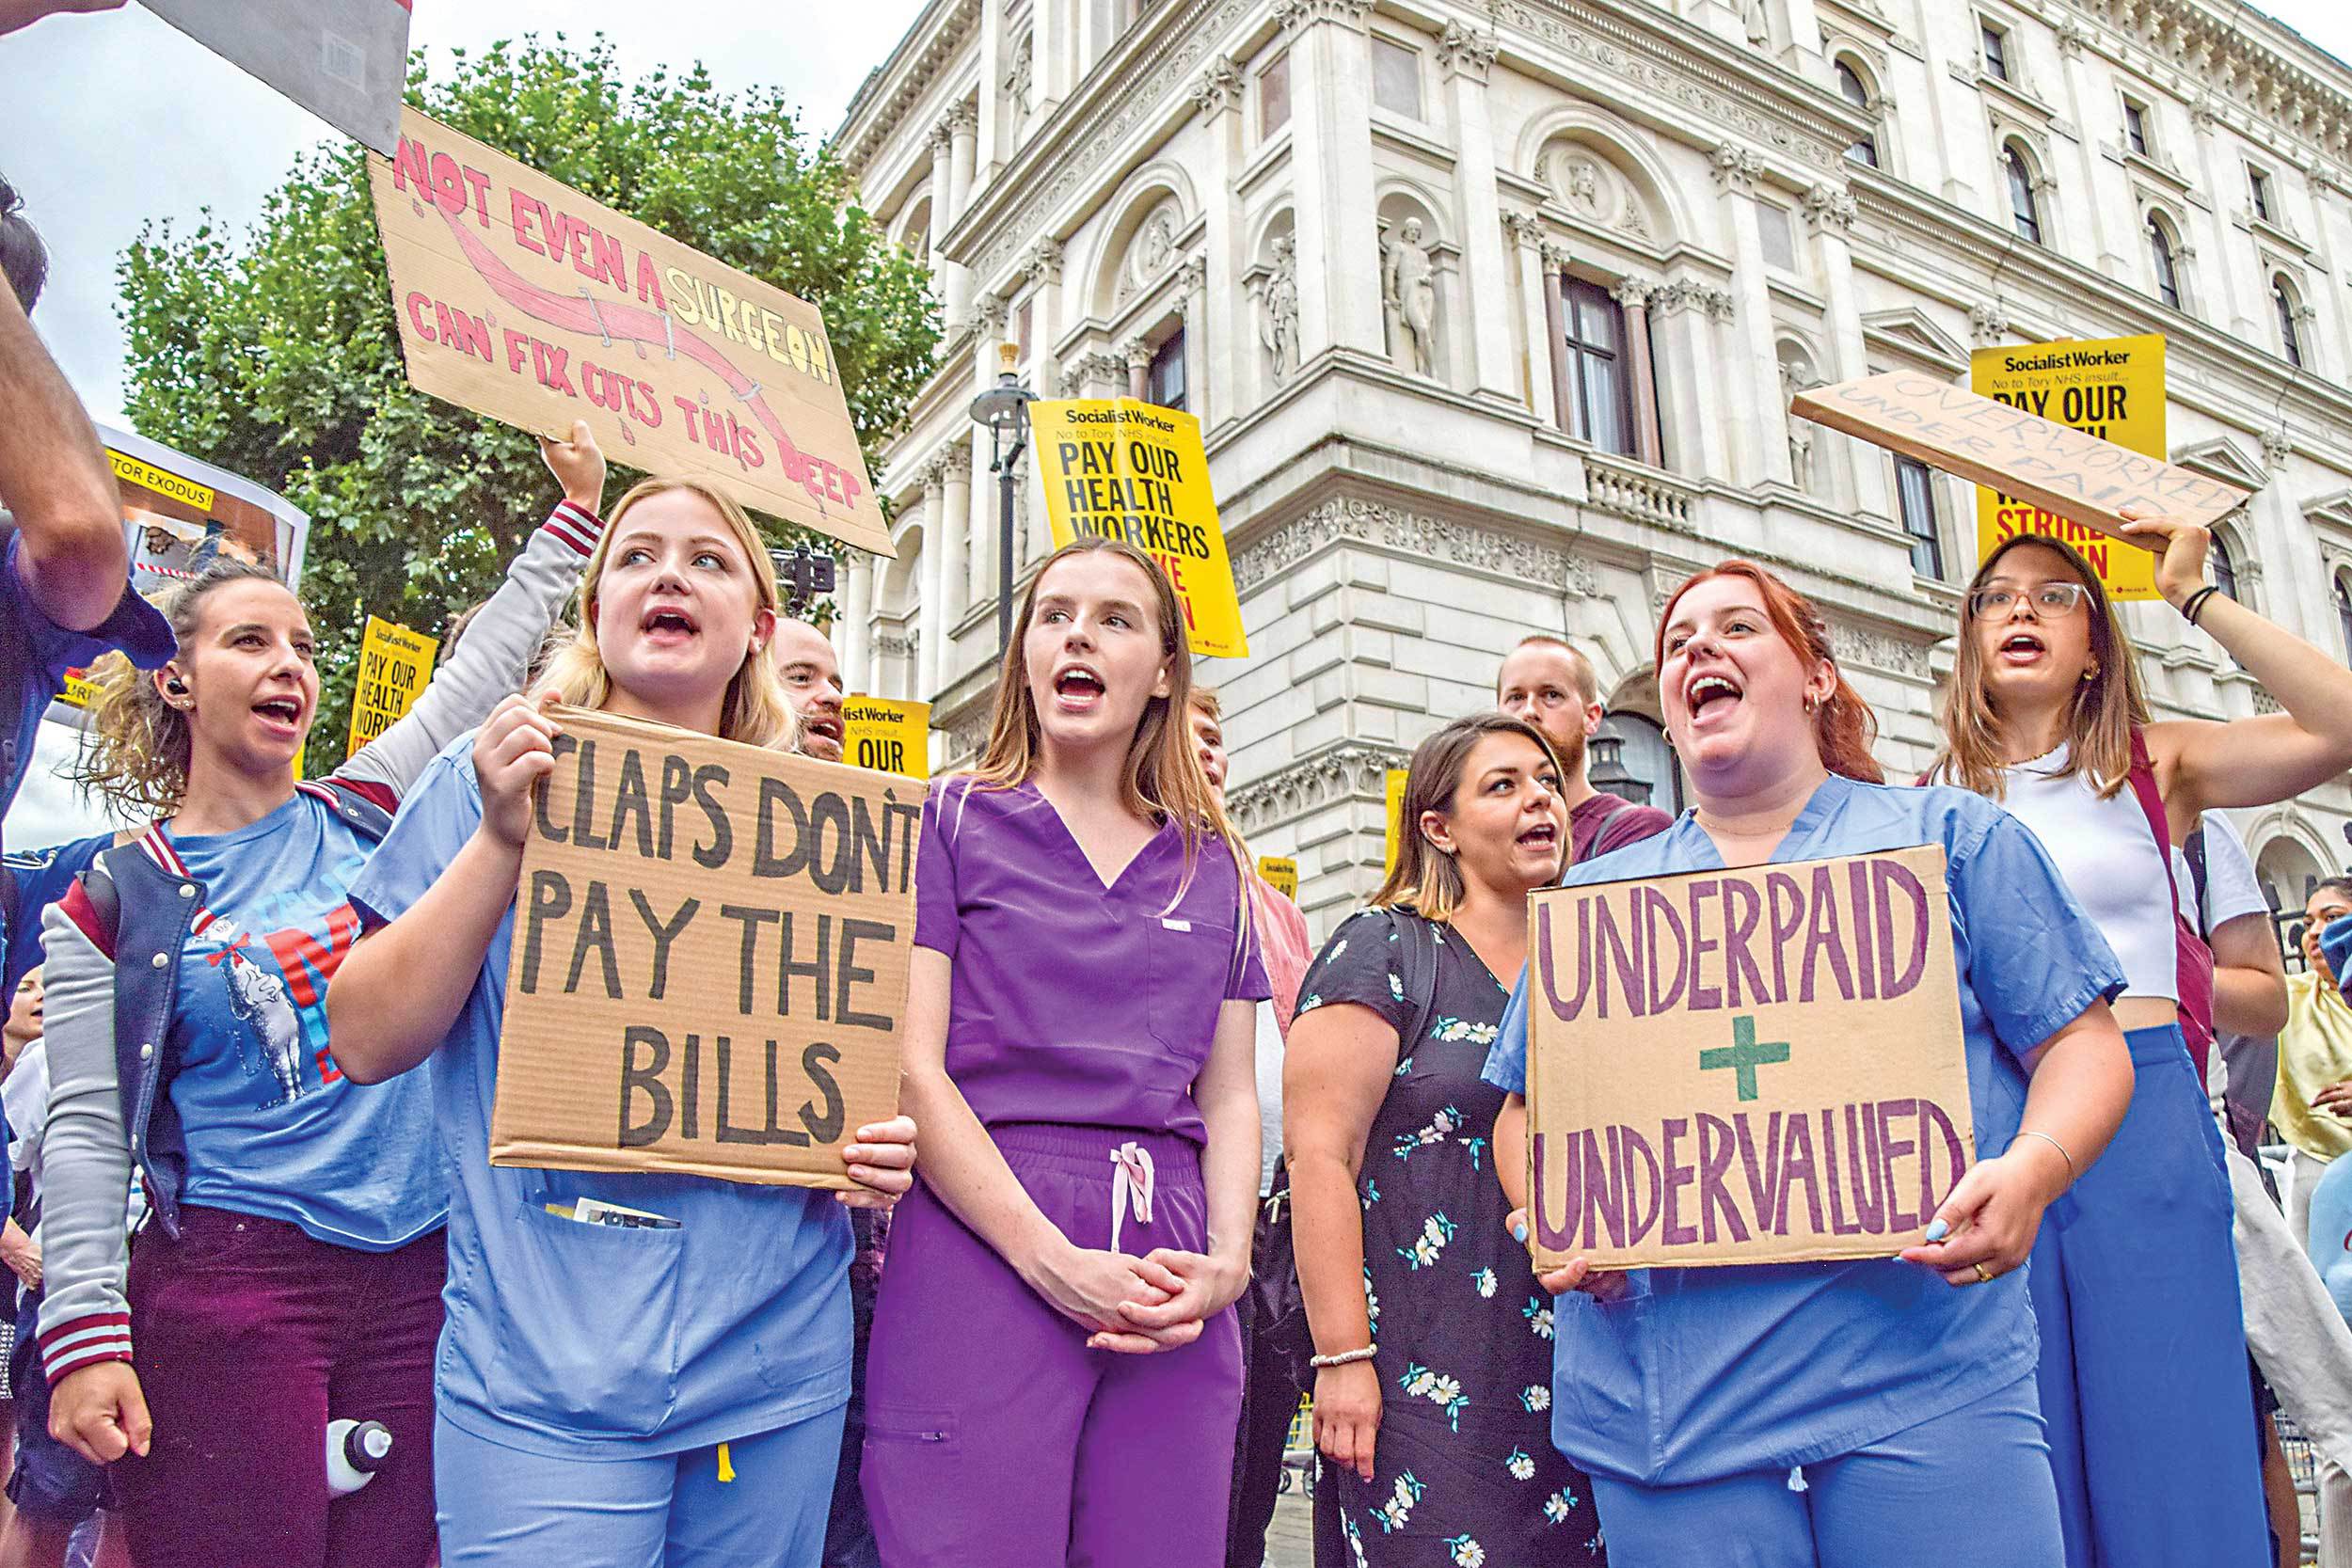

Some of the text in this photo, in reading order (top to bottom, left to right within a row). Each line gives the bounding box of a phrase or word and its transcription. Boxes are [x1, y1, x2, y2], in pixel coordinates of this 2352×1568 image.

[392, 135, 832, 384] NOT EVEN A SURGEON
[1992, 379, 2009, 389] No
[2011, 378, 2024, 388] to
[2028, 376, 2051, 389] Tory
[2055, 373, 2081, 385] NHS
[2005, 351, 2130, 372] Socialist Worker
[405, 292, 860, 509] CAN FIX CUTS THIS DEEP
[2063, 385, 2127, 423] OUR
[1066, 409, 1175, 433] Socialist Worker
[1119, 429, 1143, 439] NHS
[1058, 441, 1183, 483] PAY OUR
[1895, 379, 2240, 509] OVERWORKED
[147, 472, 212, 506] EXODUS!
[1065, 478, 1173, 515] HEALTH
[1071, 515, 1210, 560] WORKERS
[365, 651, 388, 680] PAY
[391, 660, 416, 690] OUR
[360, 679, 404, 715] HEALTH
[865, 707, 904, 723] Worker
[858, 738, 904, 772] OUR
[536, 733, 920, 895] CLAPS DON'T
[520, 870, 701, 1000] PAY
[721, 904, 896, 1032] THE
[1537, 859, 1930, 1022] UNDERPAID
[617, 1025, 846, 1149] BILLS
[1534, 1098, 1966, 1252] UNDERVALUED
